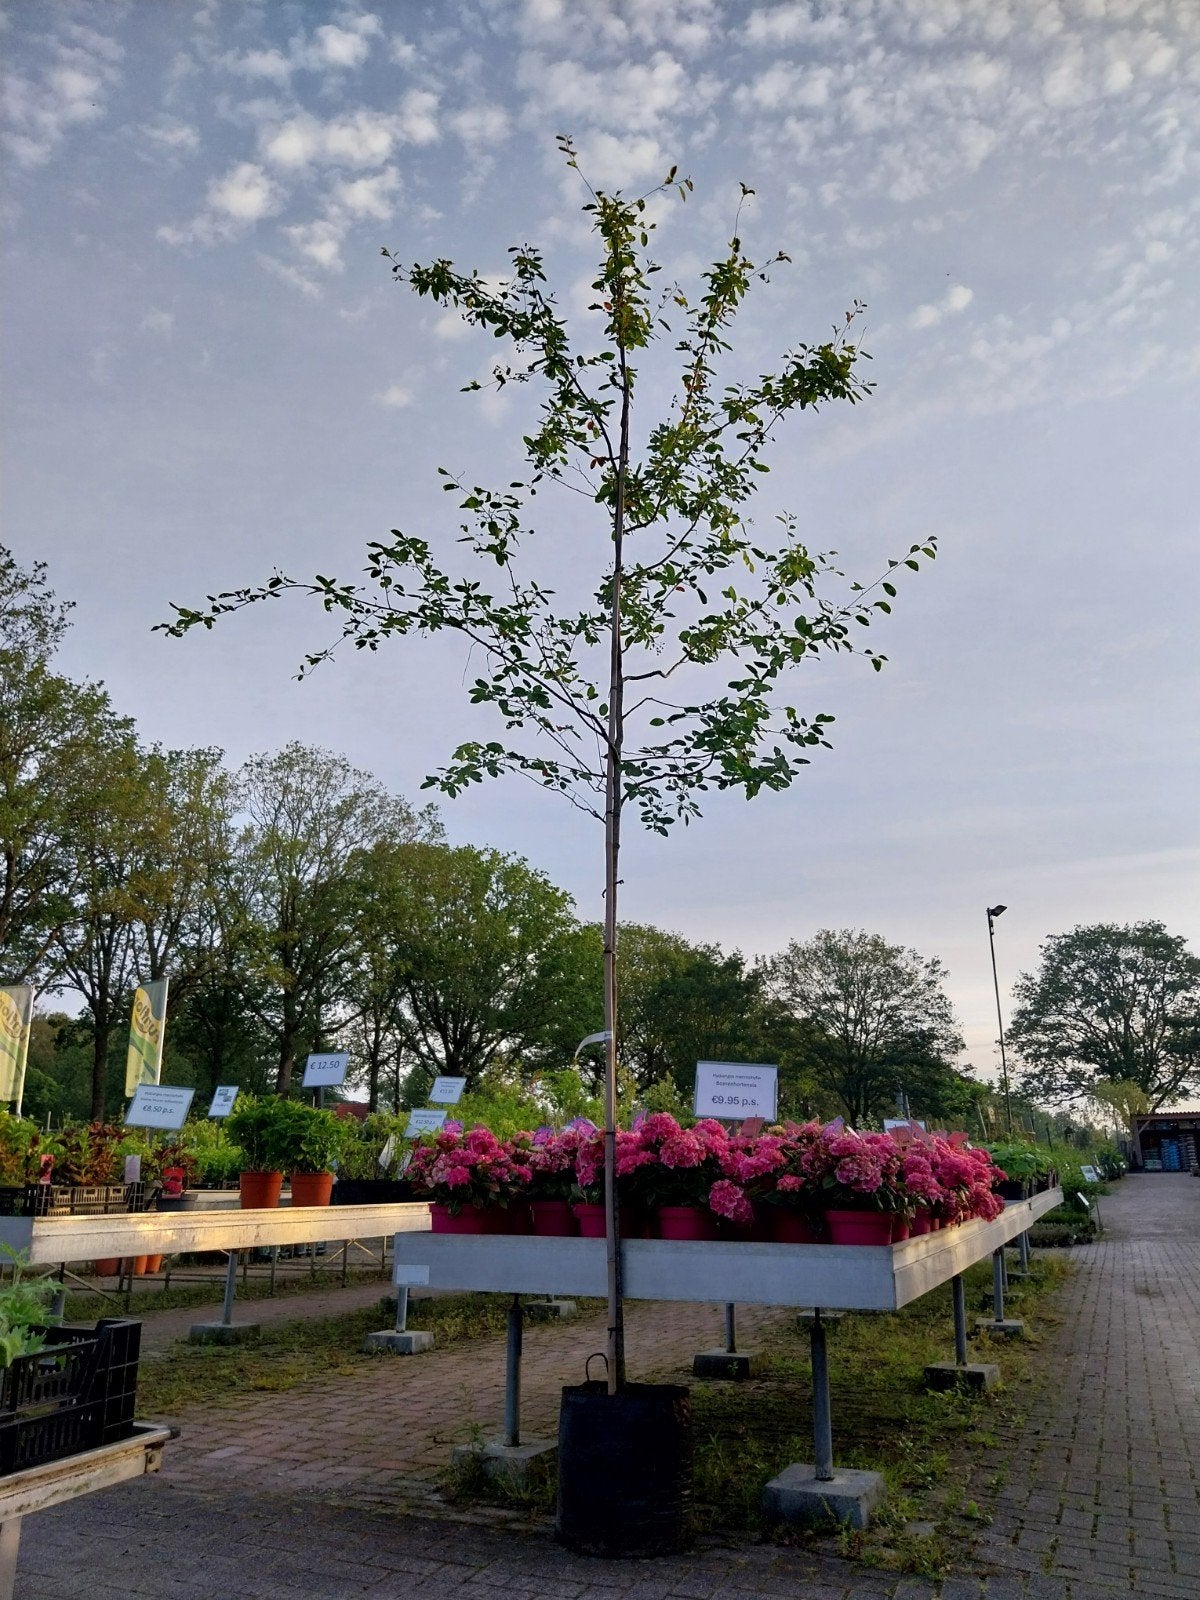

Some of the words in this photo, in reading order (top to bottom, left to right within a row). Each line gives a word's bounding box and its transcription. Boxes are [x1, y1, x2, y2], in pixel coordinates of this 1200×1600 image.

[310, 1062, 316, 1070] €
[318, 1060, 340, 1070] 12.50
[712, 1096, 740, 1104] €9.95
[742, 1098, 759, 1107] p.s.
[142, 1104, 162, 1114] €8.50
